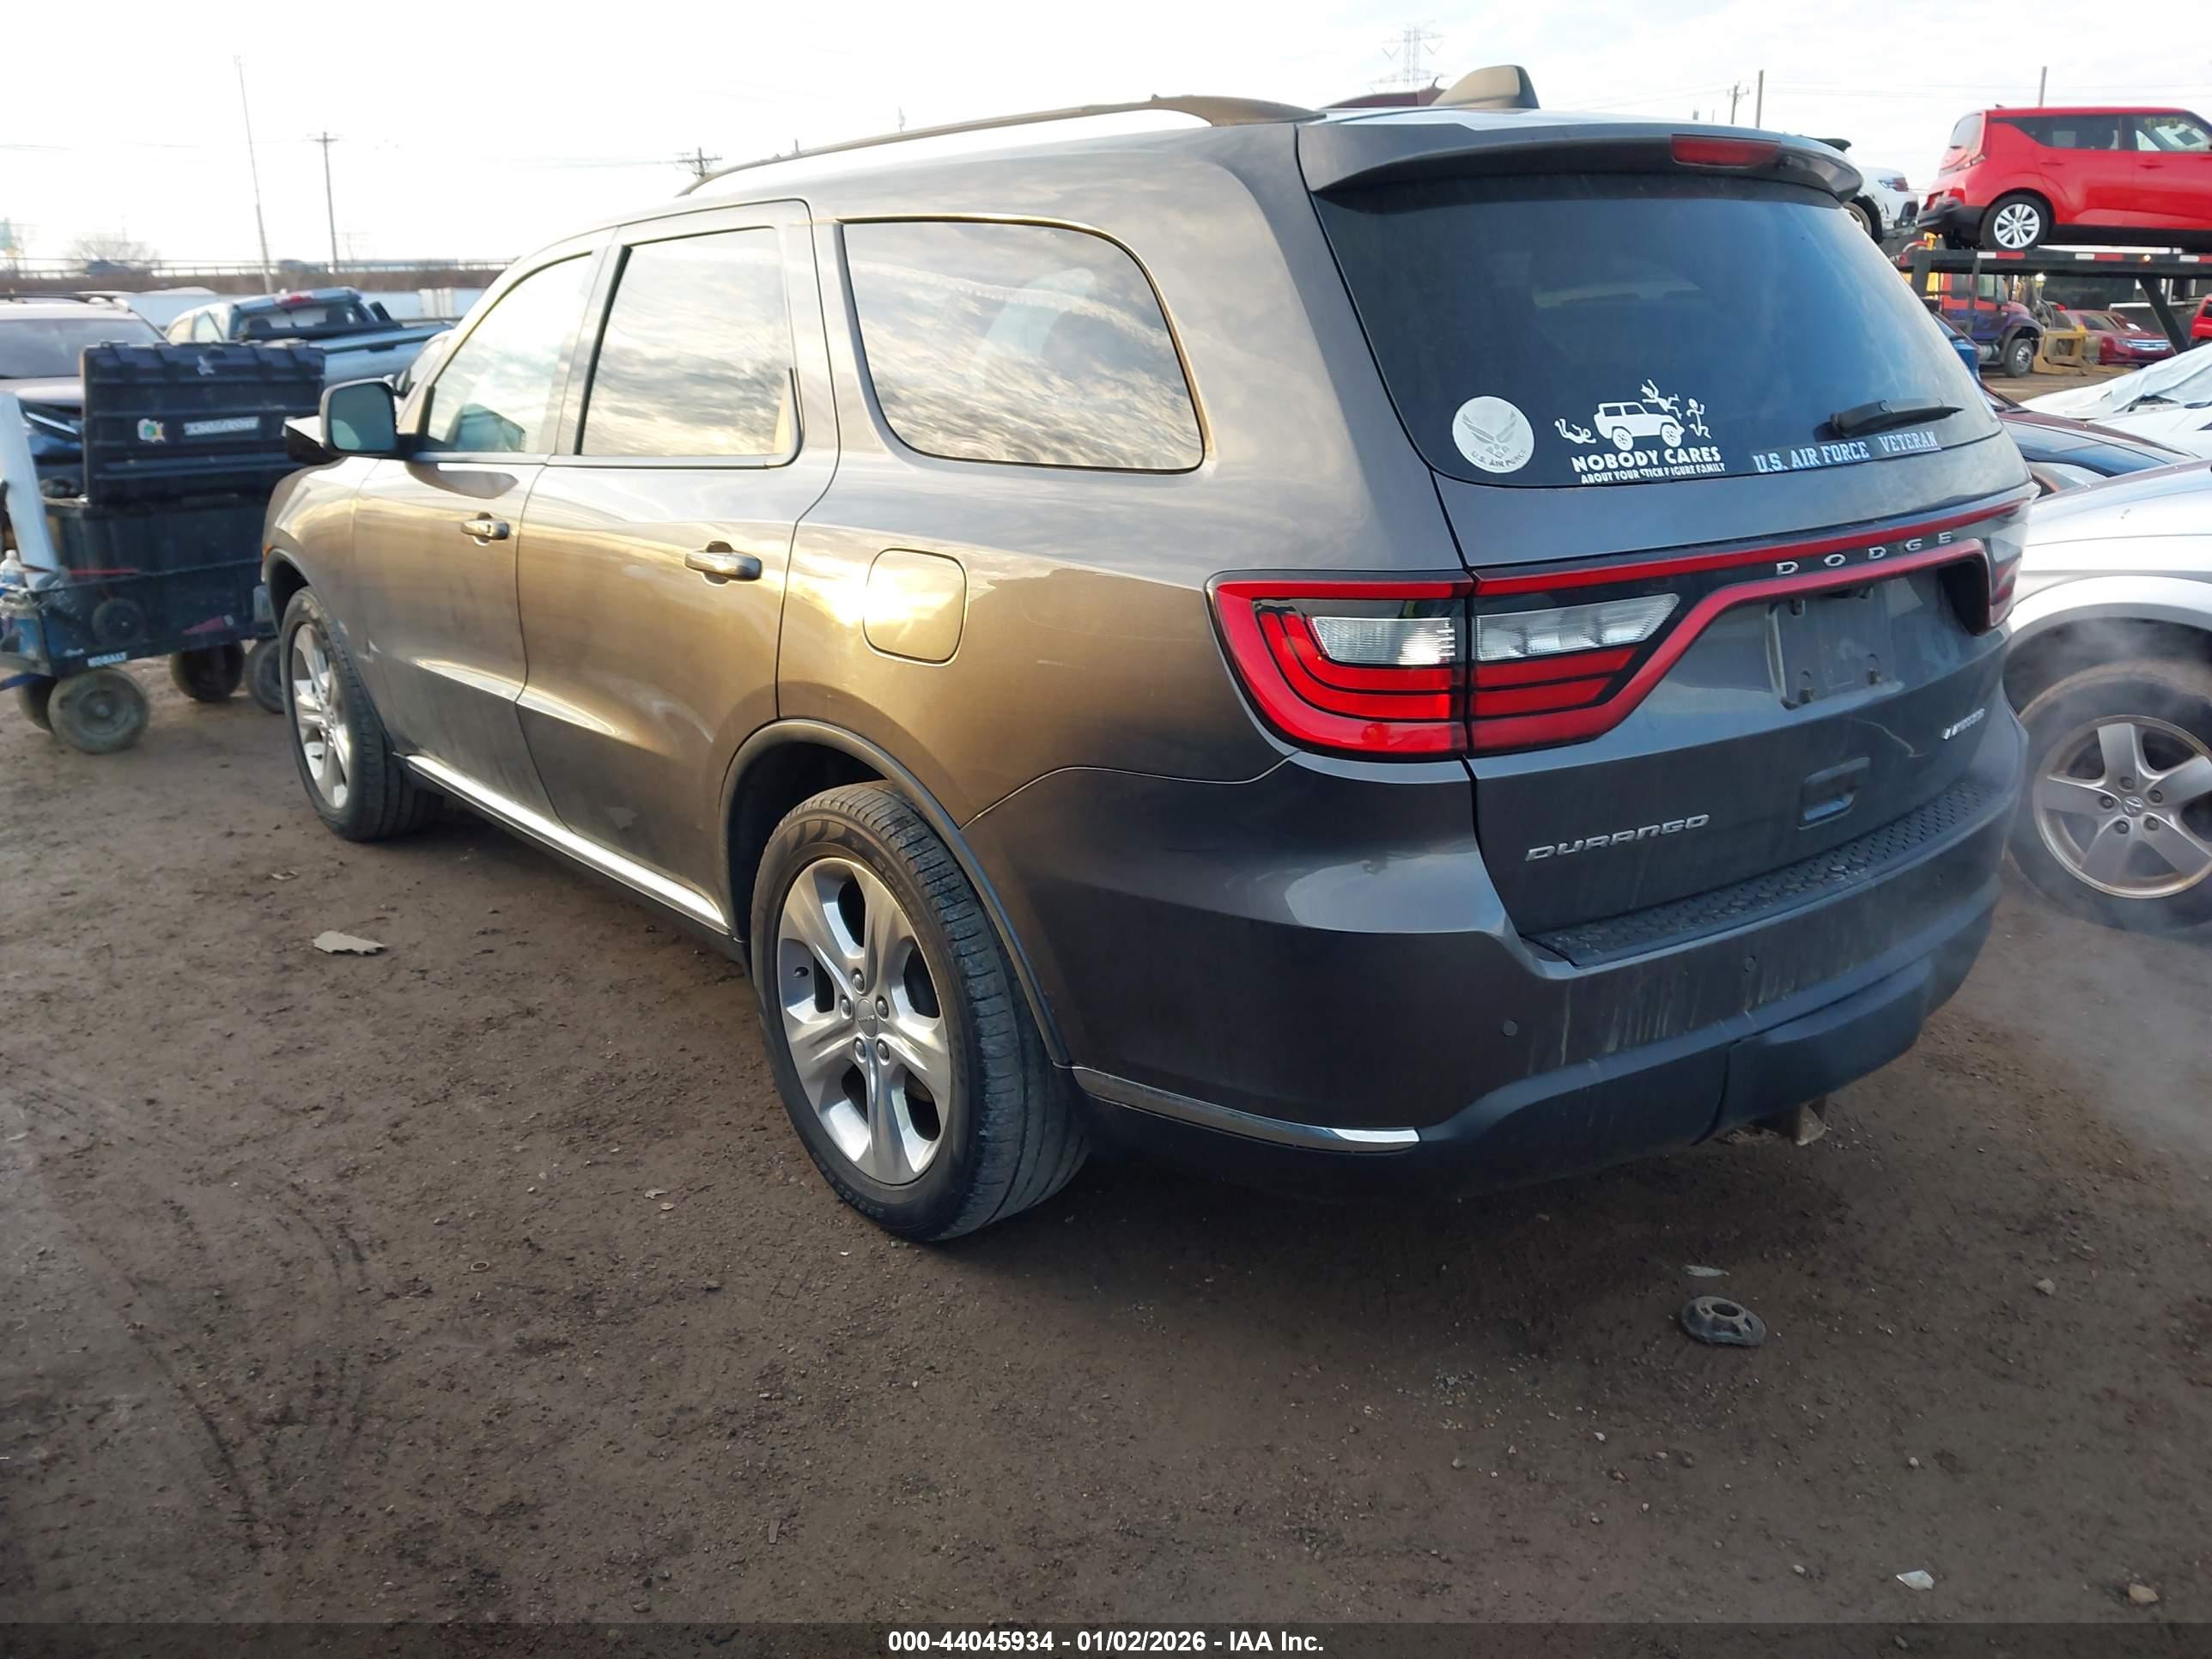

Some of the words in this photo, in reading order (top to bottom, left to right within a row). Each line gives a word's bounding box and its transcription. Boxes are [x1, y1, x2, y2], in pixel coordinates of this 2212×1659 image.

[1571, 449, 1659, 473] NOBODY
[1663, 446, 1722, 465] CARES
[1752, 452, 1787, 473] U.S.
[1790, 447, 1820, 469] AIR
[1820, 441, 1871, 465] FORCE
[1878, 430, 1938, 453] VETERAN
[1581, 471, 1613, 484] ABOUT
[1613, 469, 1641, 481] YOUR
[1776, 531, 1954, 576] DODGE
[1525, 814, 1711, 861] DURANGO
